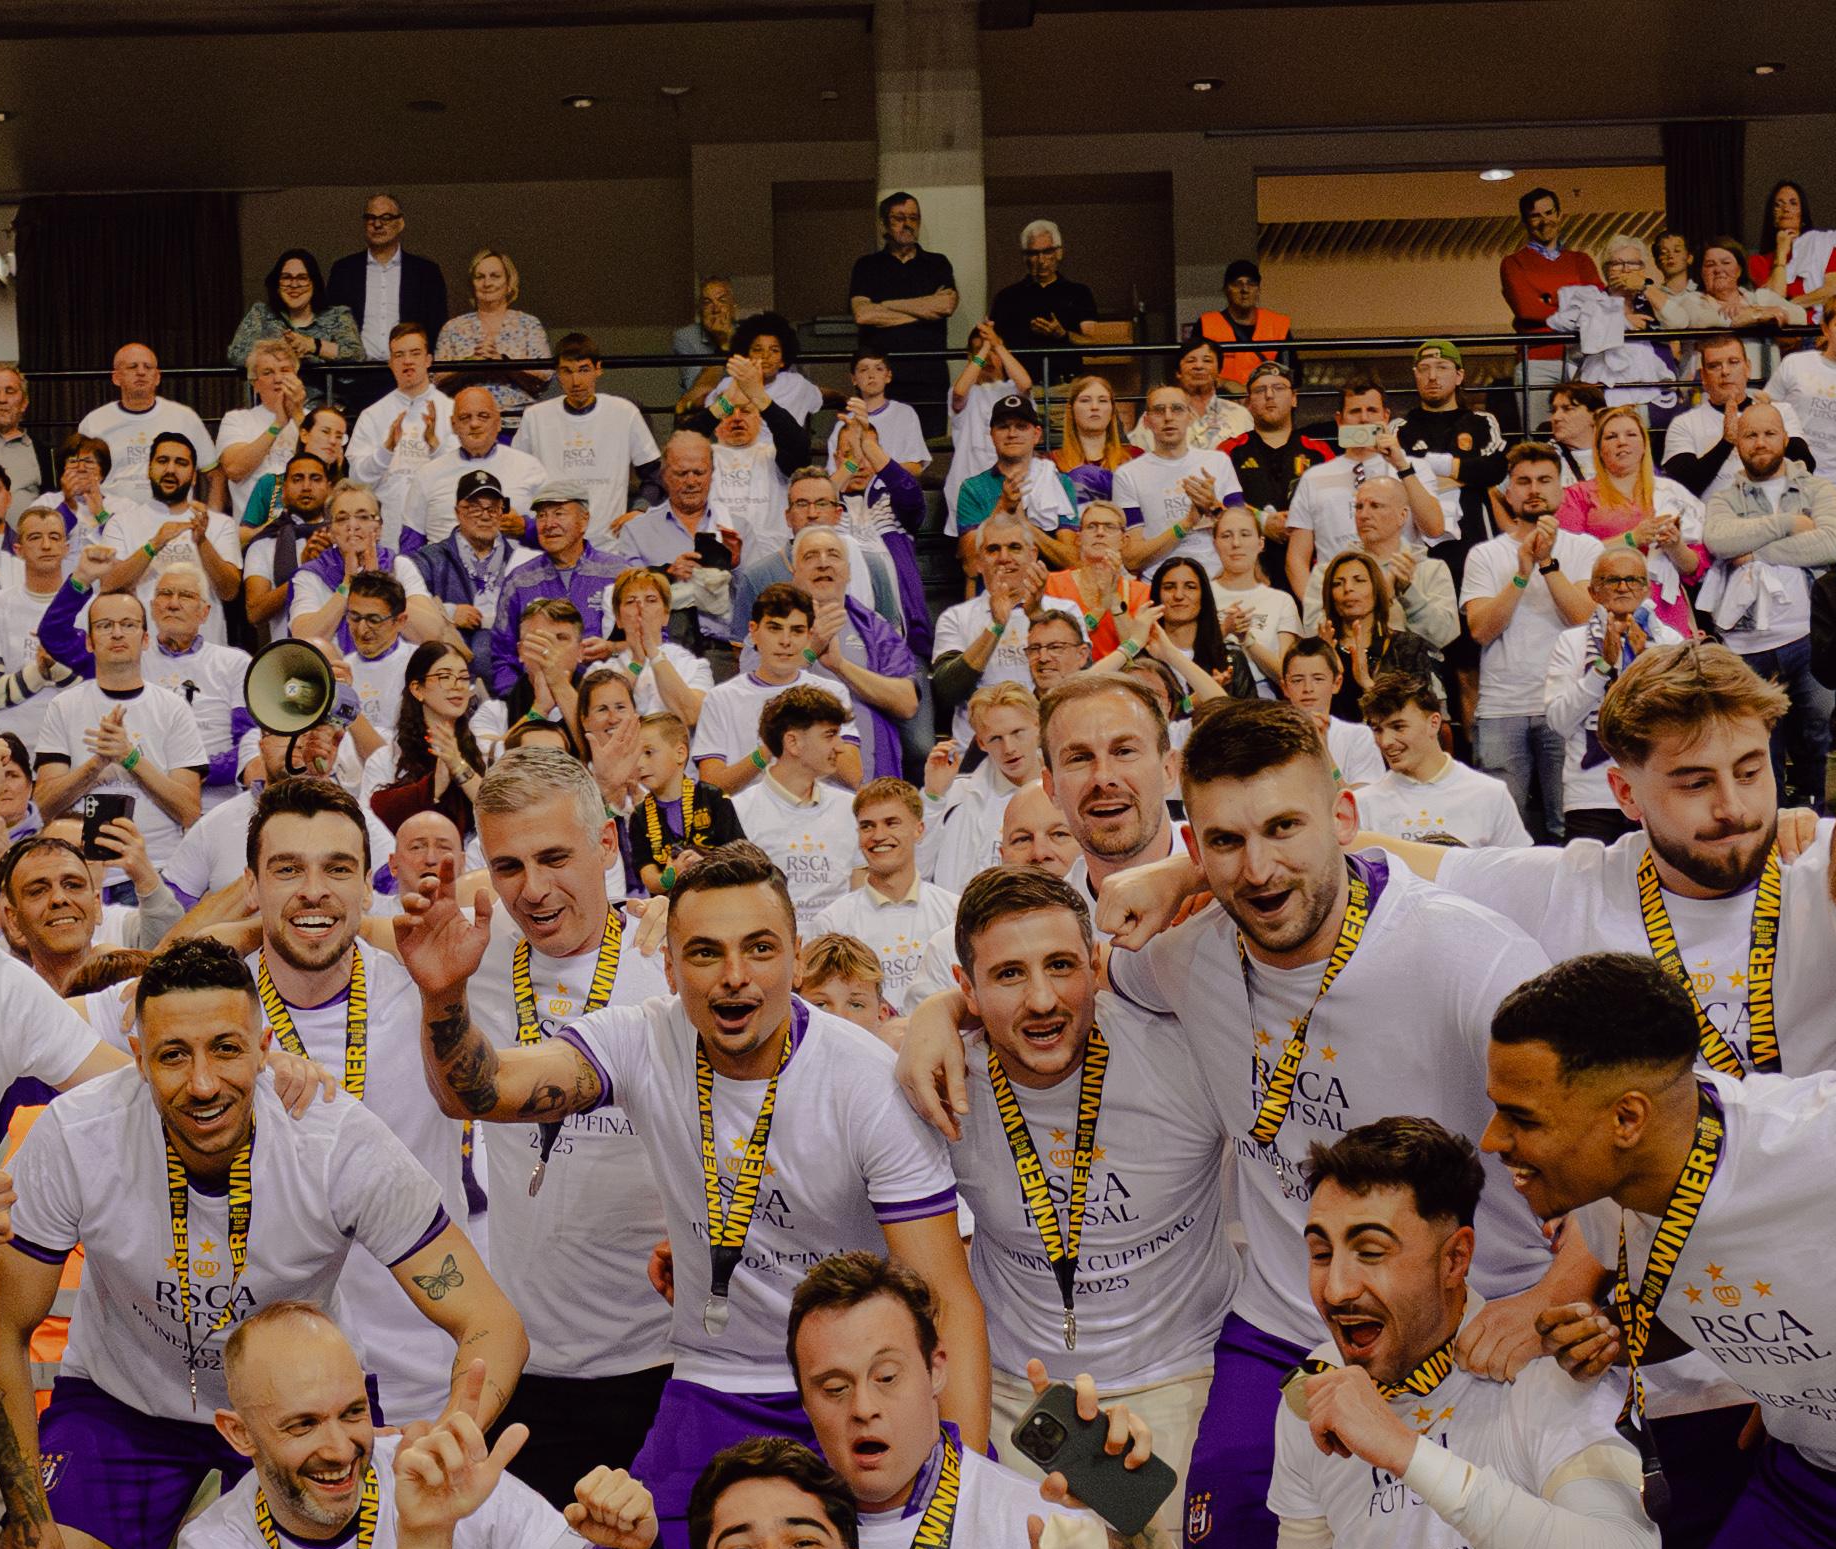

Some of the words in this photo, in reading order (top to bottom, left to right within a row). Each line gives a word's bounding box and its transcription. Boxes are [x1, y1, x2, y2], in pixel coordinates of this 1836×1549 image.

[786, 856, 831, 873] RSCA
[786, 872, 832, 885] FUTSAL
[1748, 946, 1782, 1065] WINNER
[1250, 1055, 1350, 1109] RCA
[1250, 1037, 1304, 1145] WINNER
[701, 1140, 724, 1246] WINNER
[721, 1143, 767, 1247] WINNER
[1016, 1152, 1065, 1263] WINNER
[1067, 1150, 1093, 1259] WINNER
[1649, 1147, 1718, 1277] WINNER
[1087, 1215, 1196, 1272] CUPFINAL
[155, 1280, 257, 1309] RSCA
[1075, 1275, 1131, 1296] 2025
[1690, 1309, 1814, 1344] RSCA
[1711, 1341, 1833, 1366] FUTSAL
